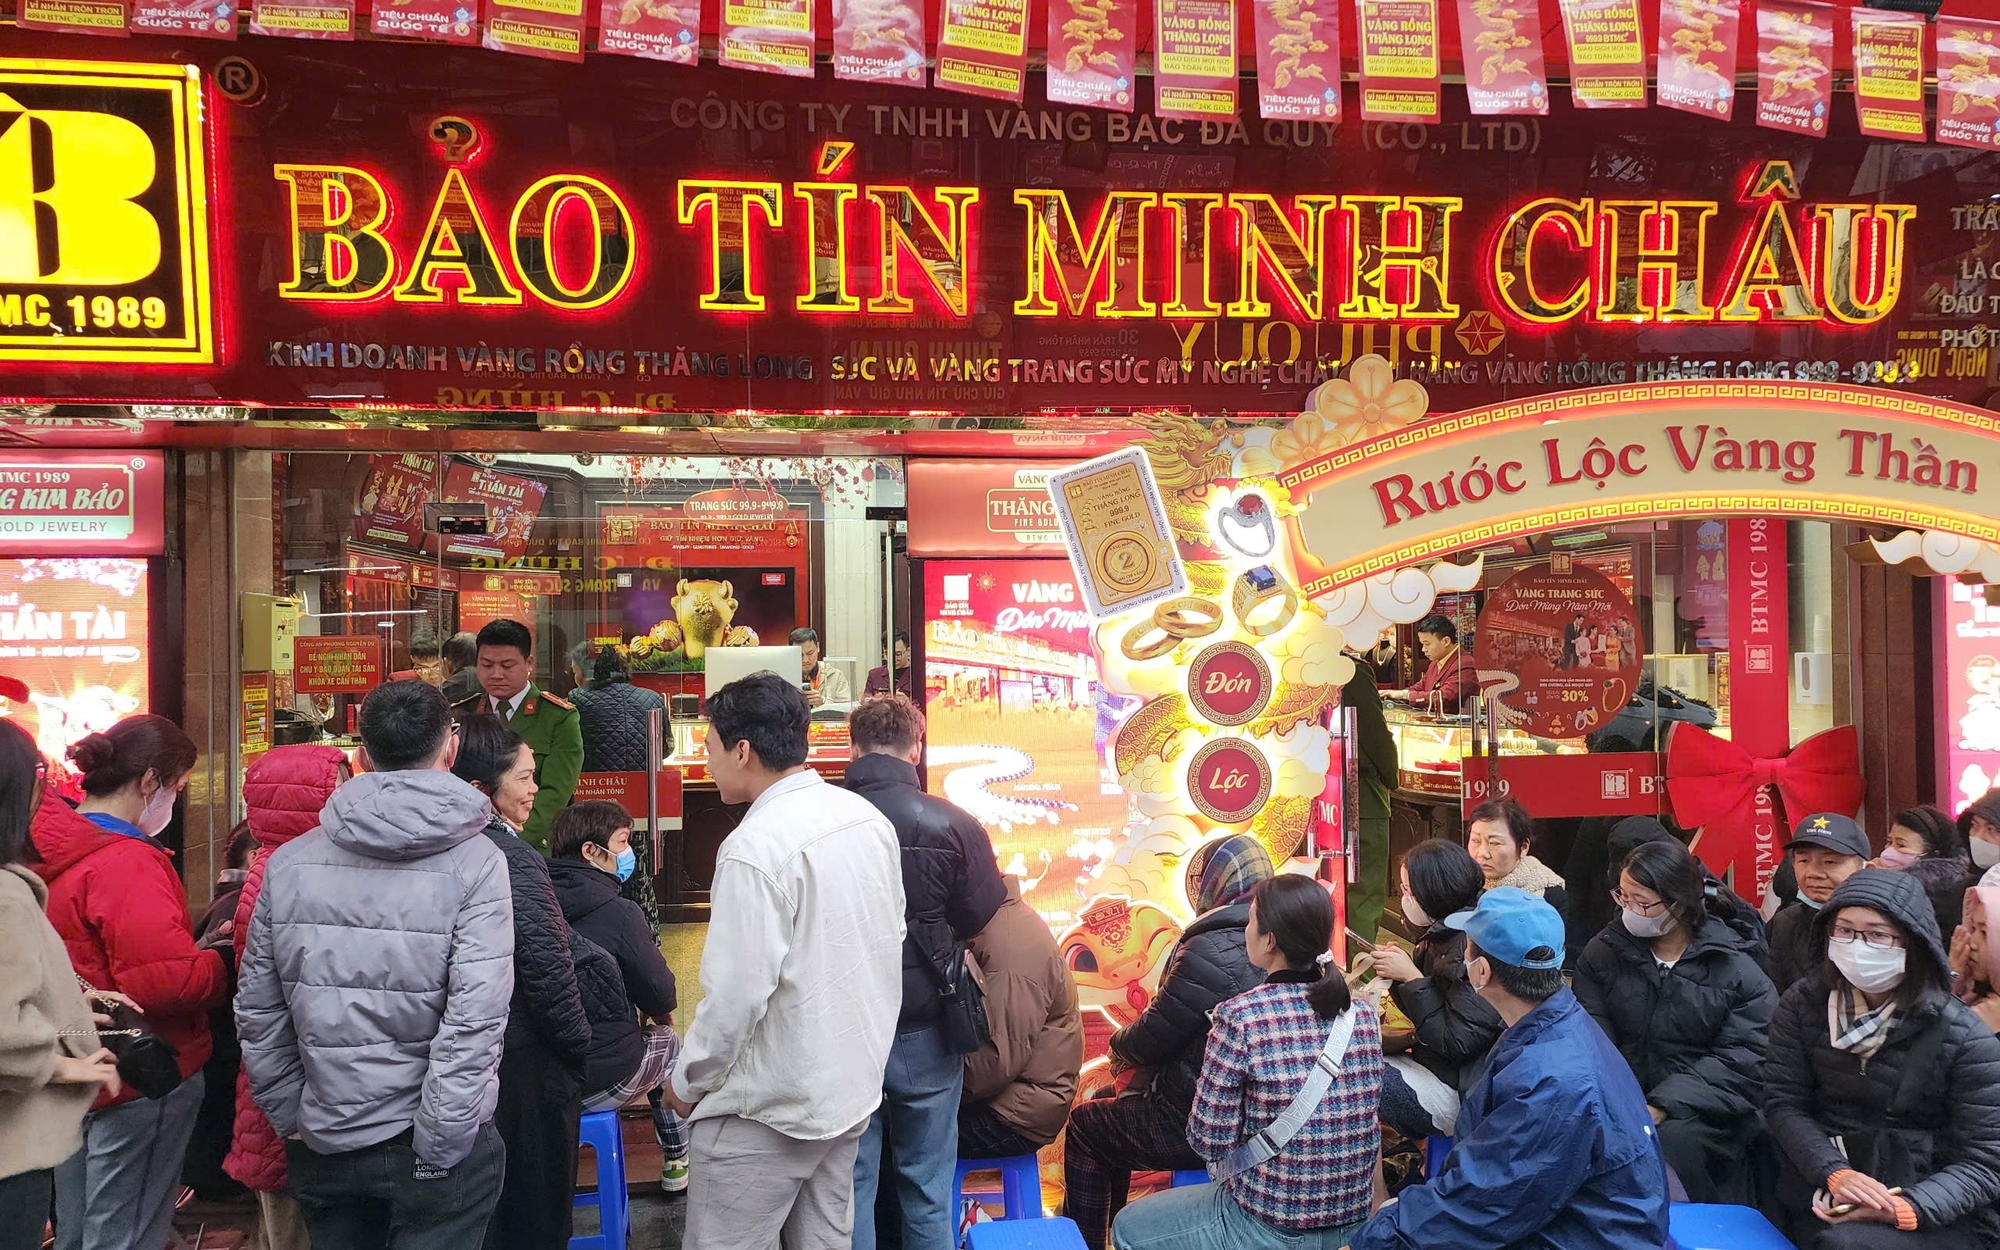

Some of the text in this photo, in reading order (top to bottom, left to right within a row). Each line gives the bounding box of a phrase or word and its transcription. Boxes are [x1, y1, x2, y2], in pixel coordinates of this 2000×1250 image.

[992, 9, 1022, 23] LONG
[97, 19, 123, 27] GOLD
[1609, 22, 1636, 32] LONG
[1202, 33, 1231, 46] LONG
[1405, 34, 1432, 46] LONG
[554, 42, 578, 51] GOLD
[997, 81, 1019, 91] GOLD
[670, 91, 786, 131] CÔNG
[800, 102, 851, 133] TY
[866, 104, 969, 138] TNHH
[985, 102, 1091, 142] VÀNG
[1107, 112, 1184, 151] BẠC
[274, 116, 1917, 325] BẢO TÍN MINH CHÂU
[67, 295, 166, 329] 1989
[265, 342, 335, 368] KINH
[341, 342, 448, 371] DOANH
[456, 340, 536, 373] VÀNG
[544, 340, 626, 376] RỒNG
[633, 345, 730, 379] THĂNG
[829, 354, 878, 381] SJC
[885, 352, 921, 382] VÀ
[929, 352, 1001, 383] VÀNG
[1008, 358, 1093, 384] TRANG
[1099, 352, 1149, 384] SỨC
[1634, 355, 1718, 382] THĂNG
[1724, 360, 1791, 381] LONG
[35, 472, 71, 484] 1989
[1370, 423, 1979, 527] Rước Lộc Vàng Thần
[20, 482, 124, 510] KIM BẢO
[508, 482, 526, 499] TÀI
[690, 498, 739, 511] TRANG SỨC
[1119, 491, 1142, 505] LONG
[990, 498, 1056, 517] THĂNG
[1109, 504, 1130, 517] 999.9
[39, 521, 108, 532] JEWELRY
[1103, 511, 1141, 529] FINE GOLD
[1119, 551, 1134, 570] 2
[1012, 579, 1075, 603] VÀNG
[1516, 587, 1605, 599] VÀNG TRANG SỨC
[1750, 562, 1769, 634] BTMC
[1505, 599, 1530, 612] Đón
[1562, 599, 1589, 612] Năm
[1588, 600, 1613, 612] Mới
[70, 604, 126, 640] TÀI
[353, 651, 367, 661] DÂN
[327, 677, 335, 686] XE
[1205, 671, 1252, 694] Đón
[1561, 690, 1590, 703] 30%
[598, 776, 628, 786] CHÂU
[1209, 767, 1250, 794] Lộc
[585, 787, 625, 796] NHÂN TÔNG
[1463, 779, 1510, 799] 199
[415, 1169, 448, 1178] ENGLAND
